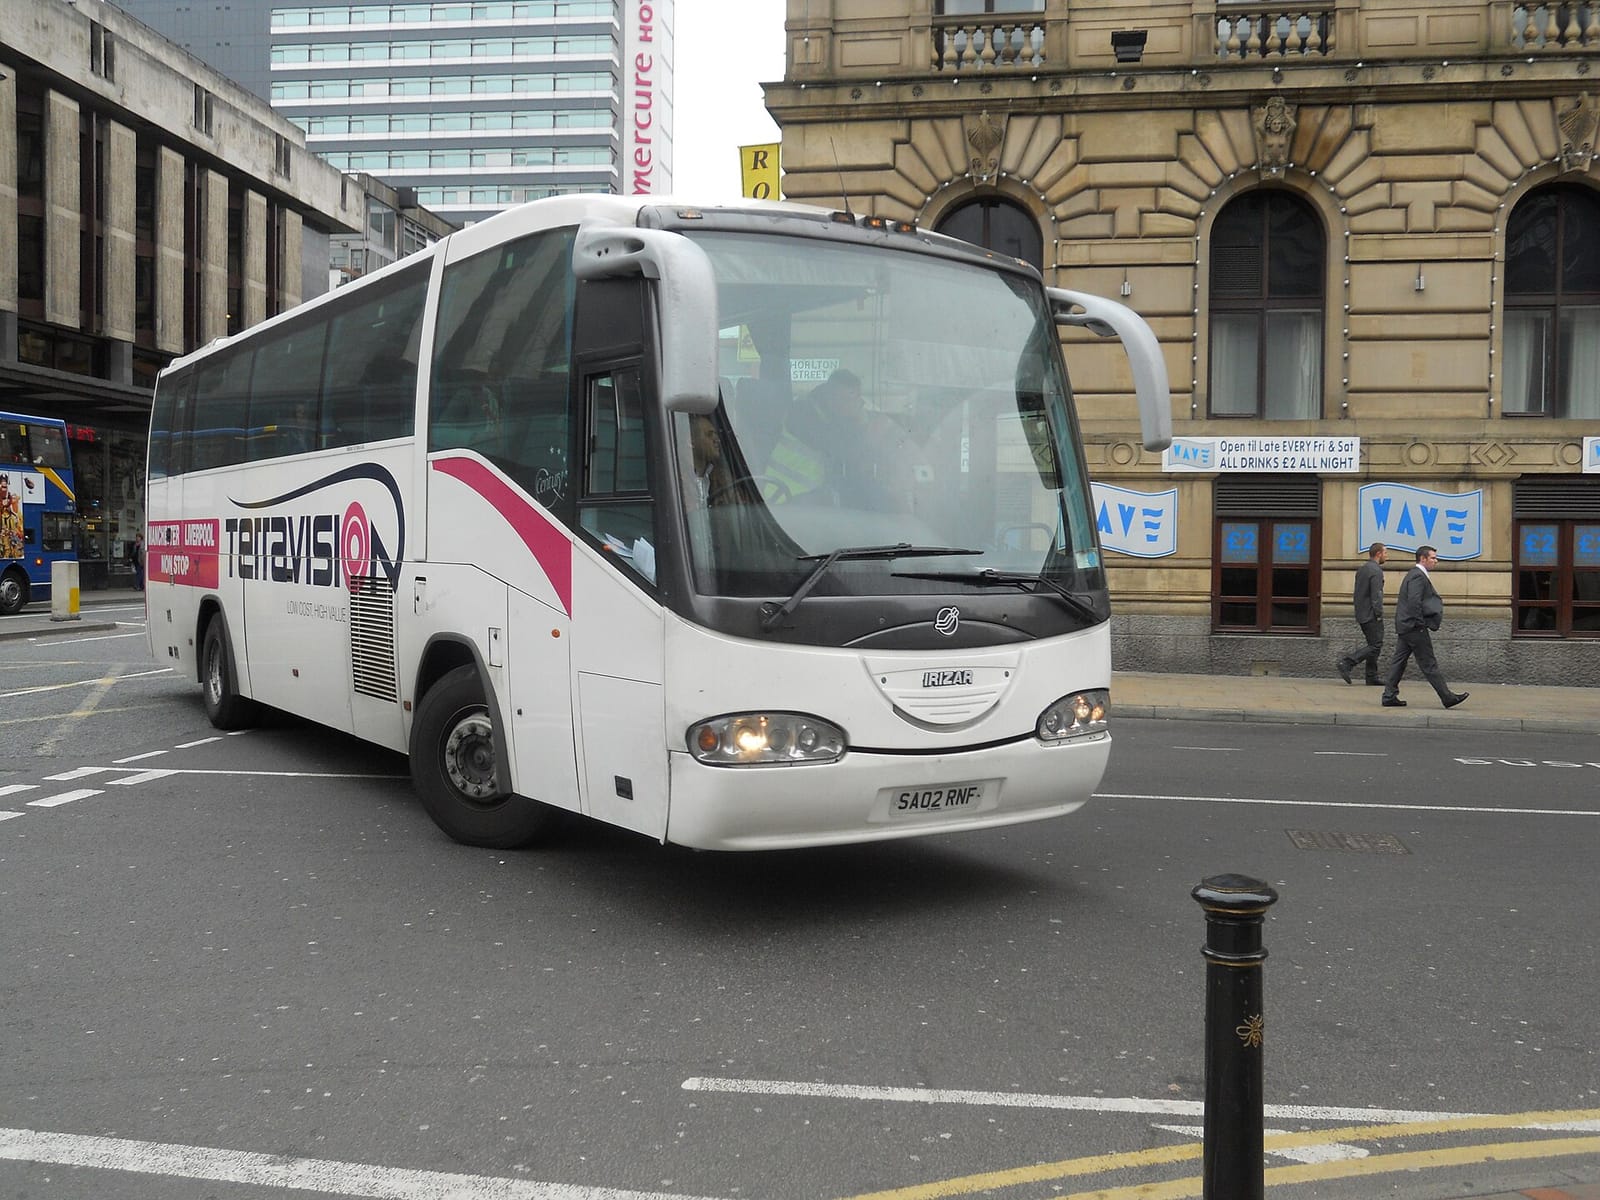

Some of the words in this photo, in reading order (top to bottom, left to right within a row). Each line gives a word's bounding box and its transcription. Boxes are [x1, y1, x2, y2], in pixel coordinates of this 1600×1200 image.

[792, 370, 828, 379] STREET
[1173, 444, 1210, 464] WAVE
[1220, 440, 1245, 454] Open
[1248, 440, 1257, 452] til
[1259, 441, 1280, 452] Late
[1283, 441, 1312, 452] EVERY
[1314, 440, 1325, 452] Fri
[1328, 441, 1335, 452] &
[1338, 440, 1354, 452] Sat
[1220, 457, 1238, 469] ALL
[1240, 457, 1279, 469] DRINKS
[1282, 457, 1296, 469] £2
[1299, 457, 1318, 469] ALL
[1320, 457, 1354, 469] NIGHT
[1371, 497, 1468, 545] WAVE
[184, 522, 215, 547] LIVERPOOL
[1226, 531, 1256, 550] £2
[1277, 532, 1307, 551] £2
[1524, 534, 1555, 553] £2
[160, 555, 173, 575] NON
[173, 555, 190, 576] STOP
[922, 670, 974, 688] IRIZAR
[898, 790, 943, 810] SA02
[945, 786, 978, 807] RNF
